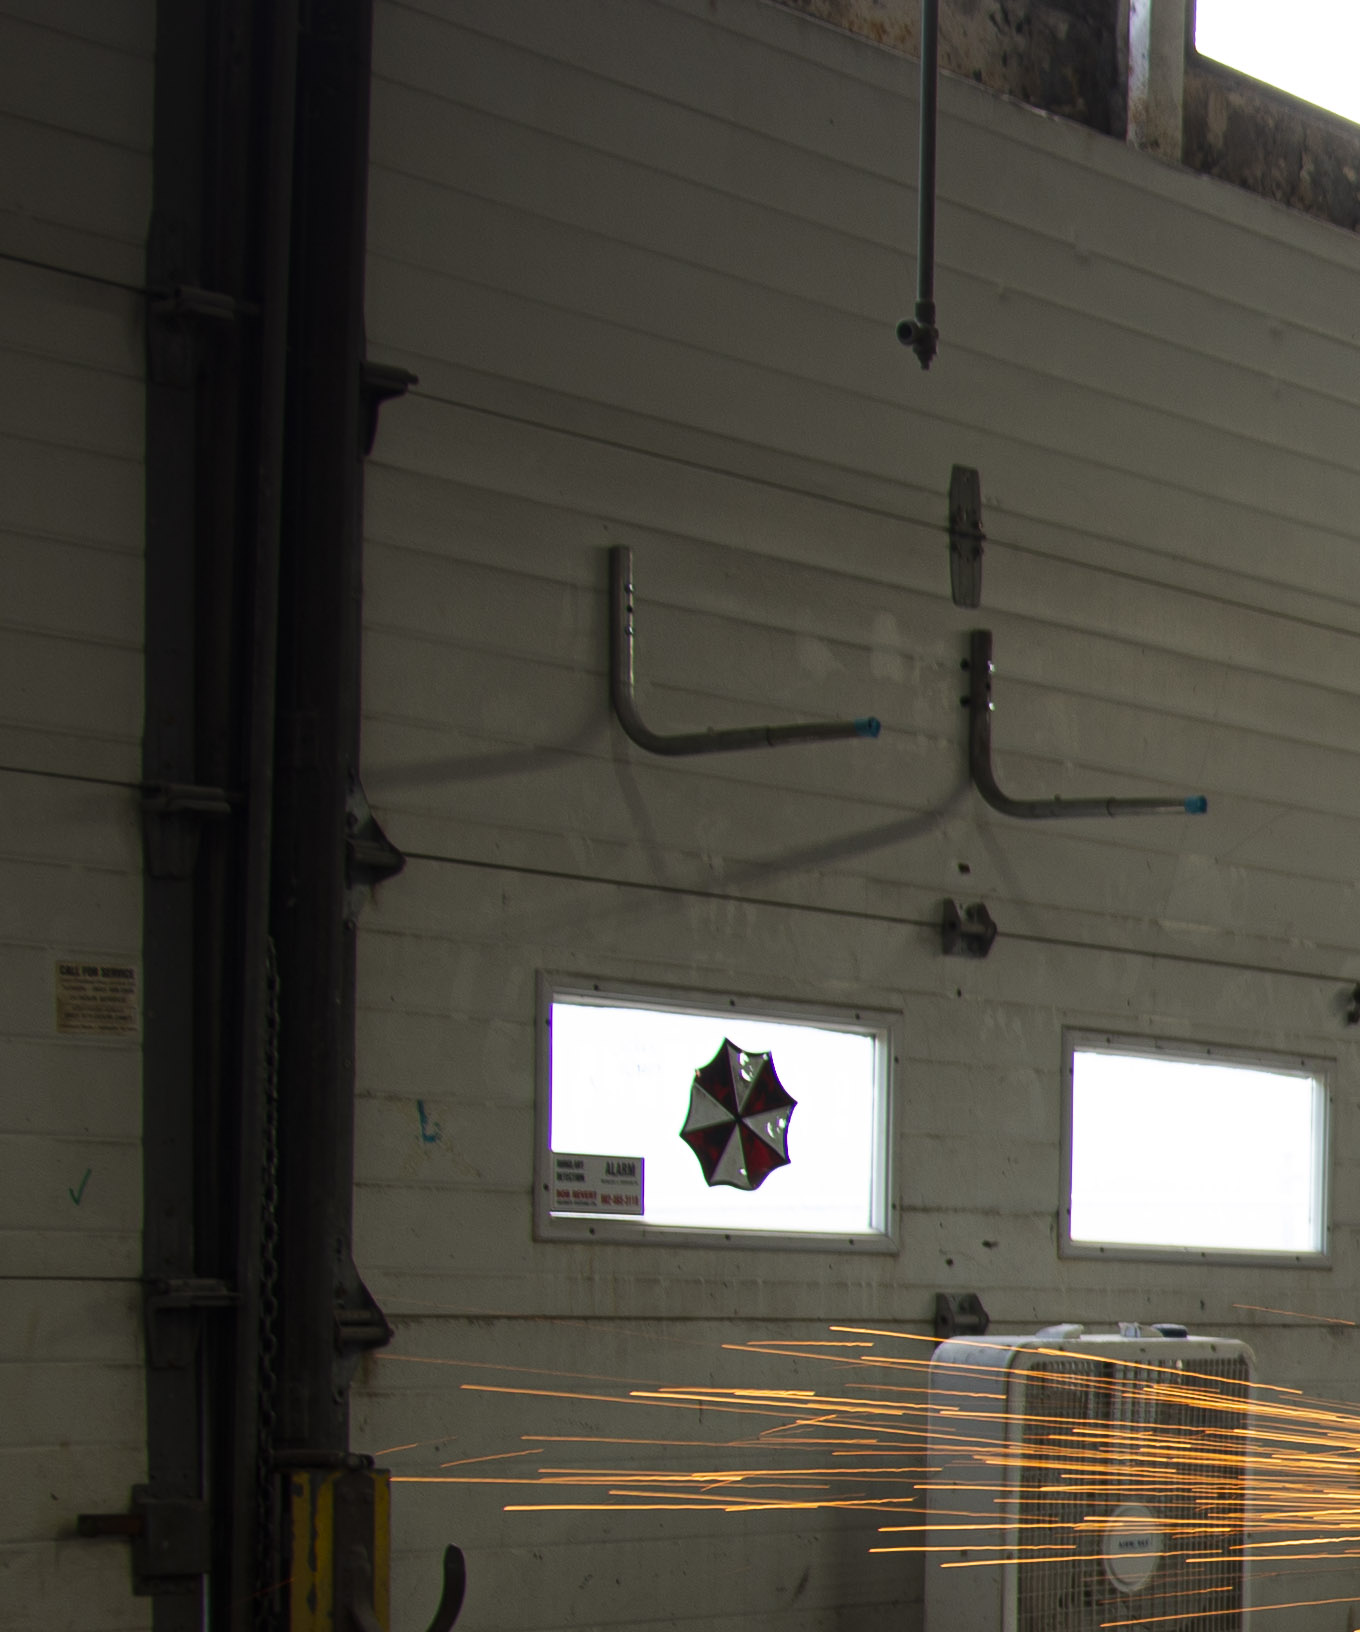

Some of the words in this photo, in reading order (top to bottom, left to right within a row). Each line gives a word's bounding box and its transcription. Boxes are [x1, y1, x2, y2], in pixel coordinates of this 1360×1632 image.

[59, 965, 80, 976] CALL
[82, 966, 98, 977] FOR
[102, 967, 135, 978] SERVICE
[605, 1161, 635, 1176] ALARM
